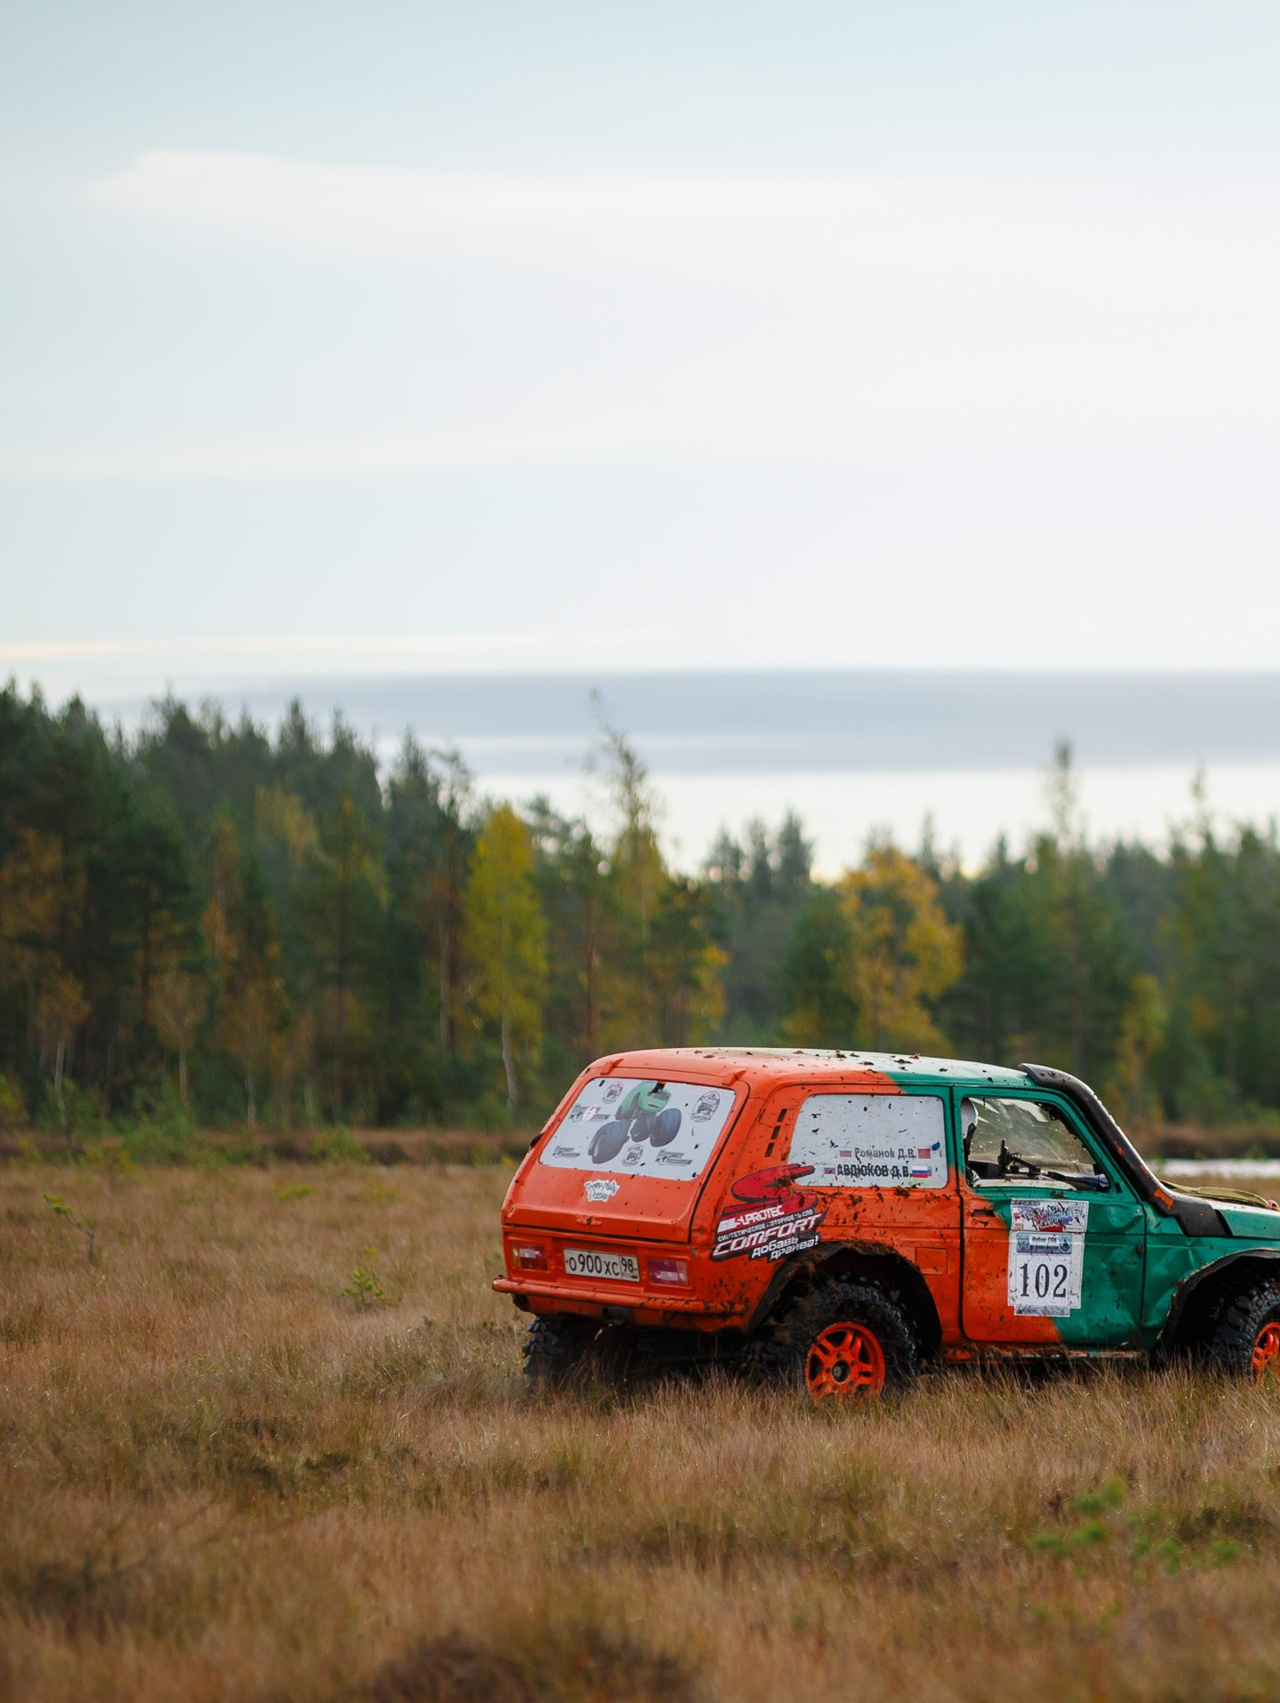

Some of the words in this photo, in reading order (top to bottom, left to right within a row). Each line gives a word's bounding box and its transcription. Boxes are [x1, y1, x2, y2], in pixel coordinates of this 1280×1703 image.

[855, 1148, 895, 1160] Романов
[712, 1213, 822, 1256] COMFORT
[621, 1257, 634, 1273] 98
[1020, 1263, 1068, 1298] 102
